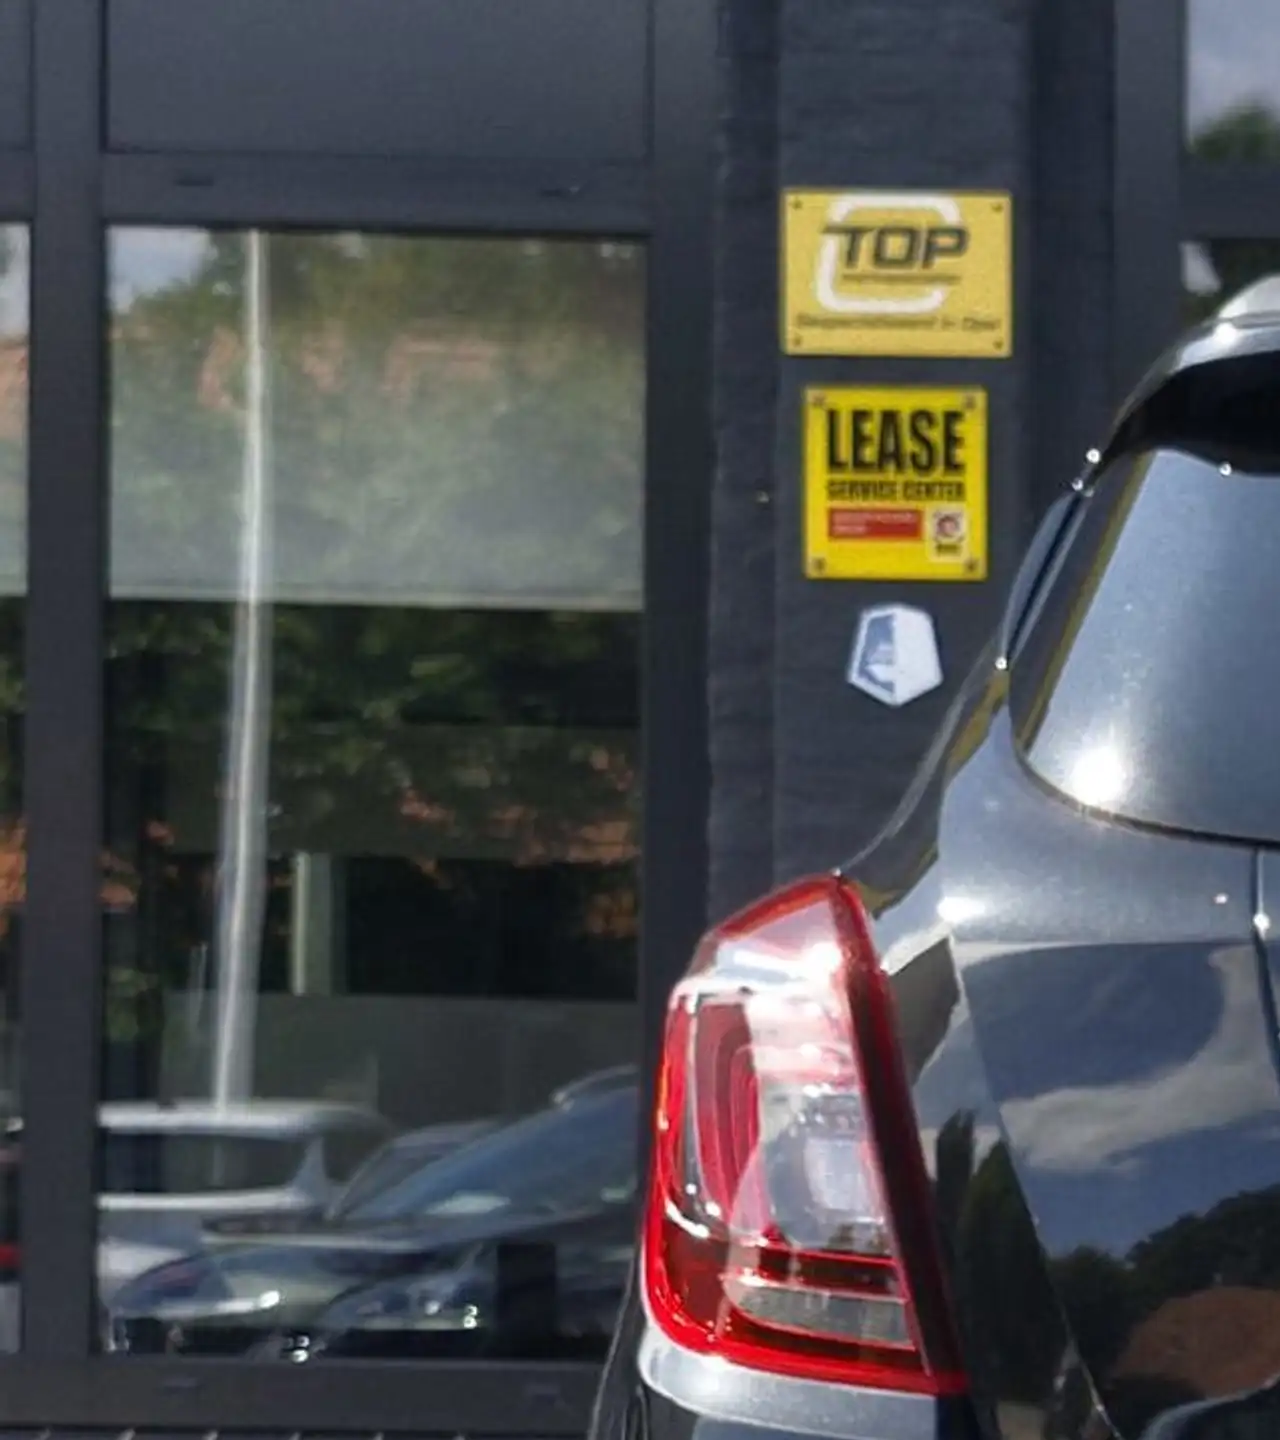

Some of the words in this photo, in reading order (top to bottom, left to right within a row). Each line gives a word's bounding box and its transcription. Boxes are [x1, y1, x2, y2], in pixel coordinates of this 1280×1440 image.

[820, 225, 970, 270] TOP
[827, 409, 966, 474] LEASE
[827, 479, 898, 501] SERVICE
